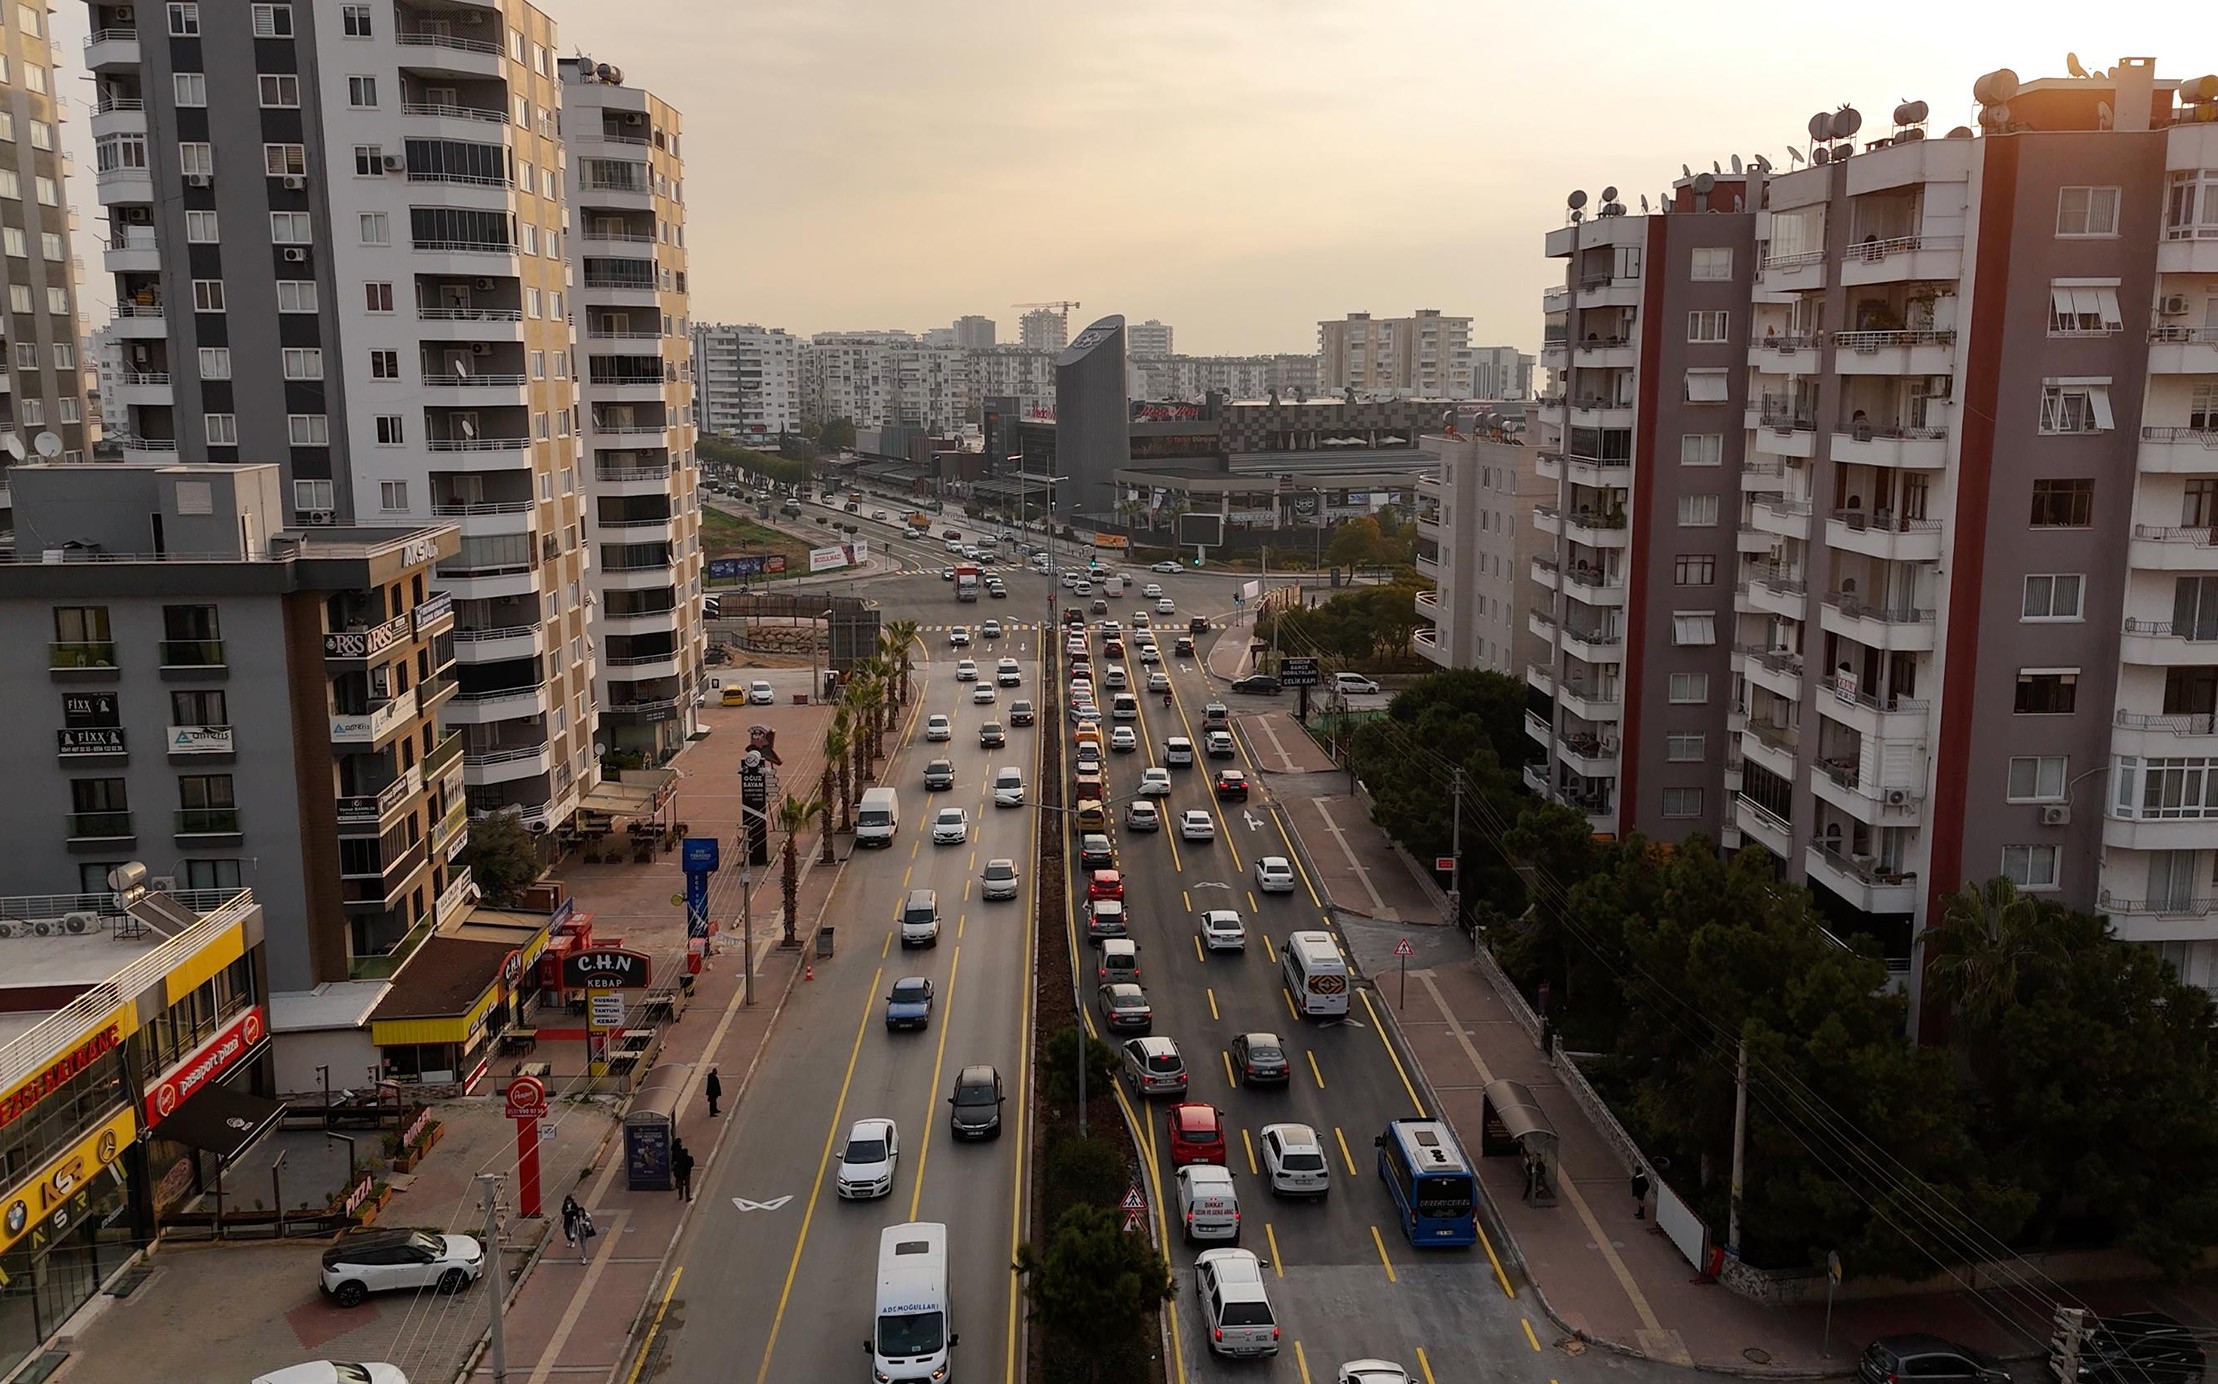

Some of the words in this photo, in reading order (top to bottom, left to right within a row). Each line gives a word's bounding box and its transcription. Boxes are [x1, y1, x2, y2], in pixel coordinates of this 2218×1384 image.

[335, 635, 365, 654] R&S
[587, 979, 623, 988] KEBAP
[345, 1175, 373, 1219] PIZZA
